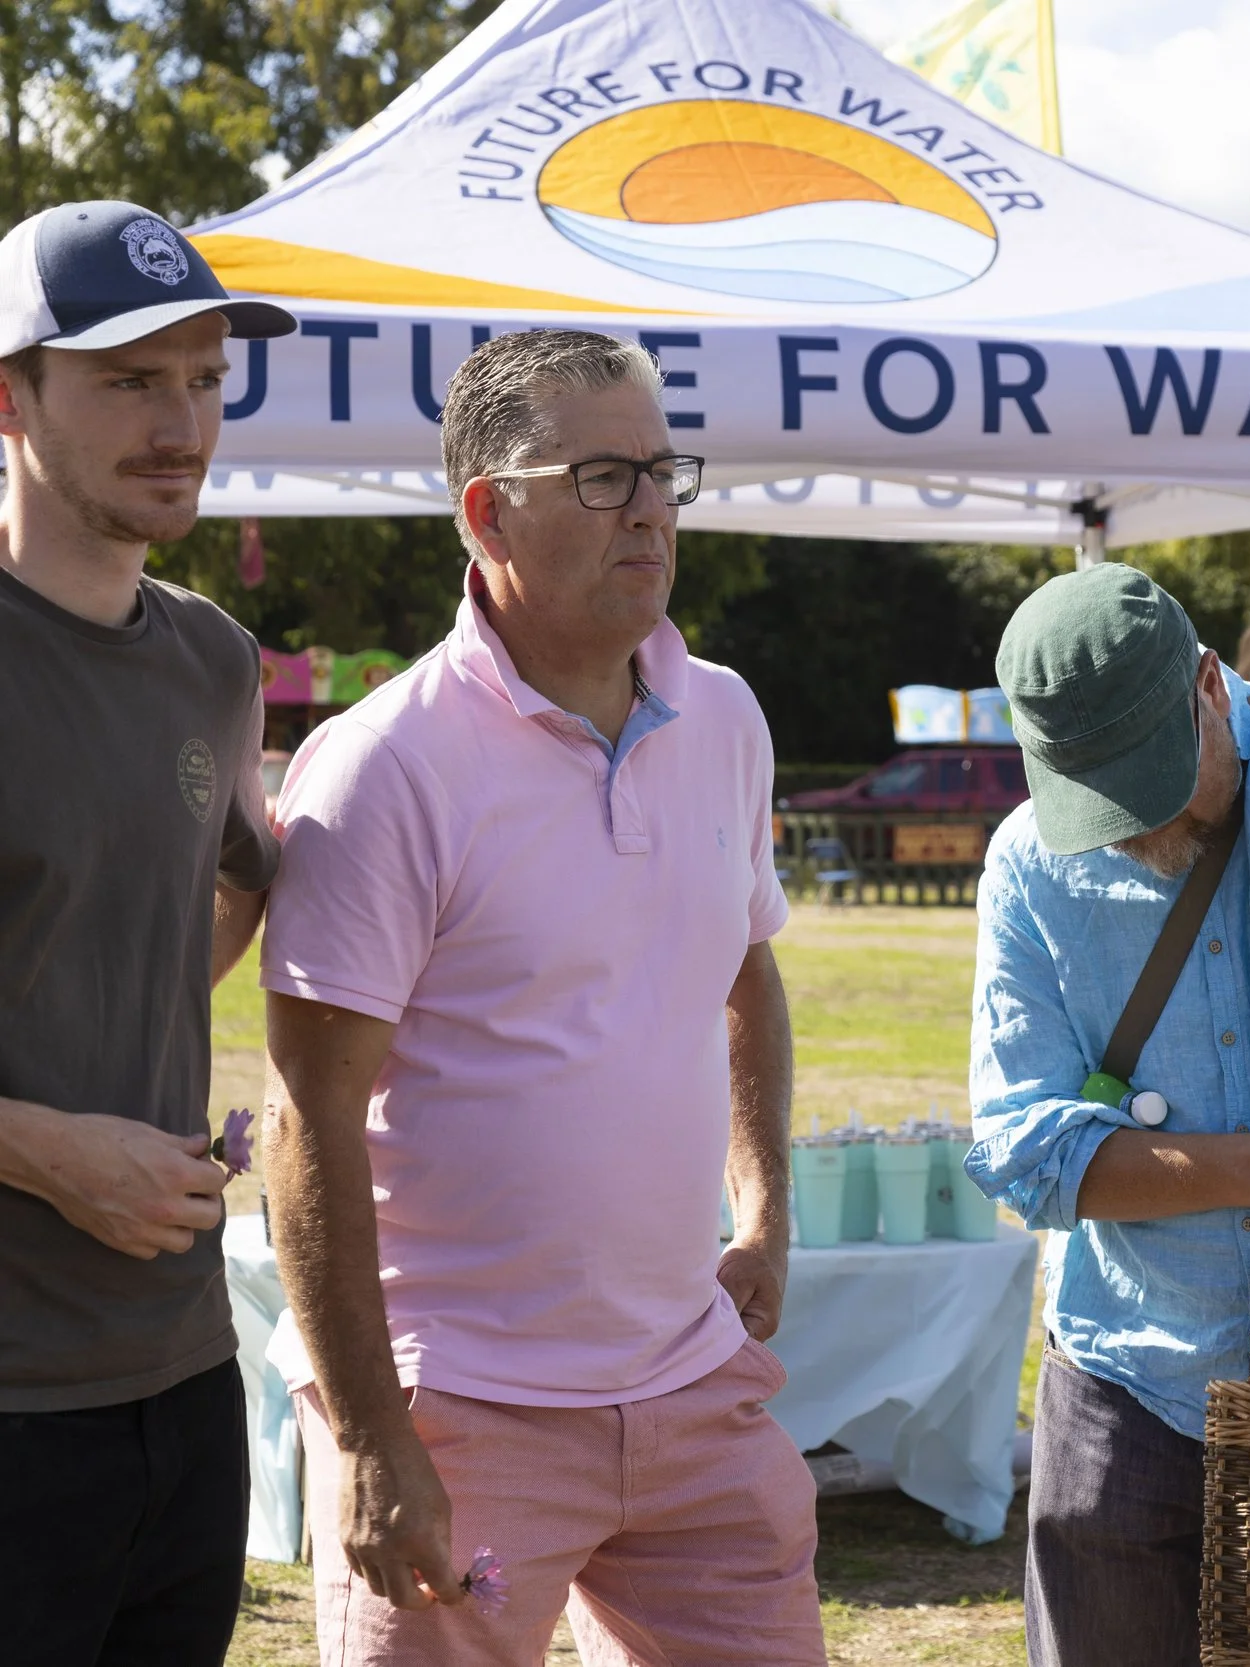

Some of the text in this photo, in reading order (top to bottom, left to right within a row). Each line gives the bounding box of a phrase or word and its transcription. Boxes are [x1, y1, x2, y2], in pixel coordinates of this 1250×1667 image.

[458, 60, 1046, 215] FUTURE FOR WATER
[222, 320, 706, 430] UTUE
[778, 334, 1052, 435] FOR
